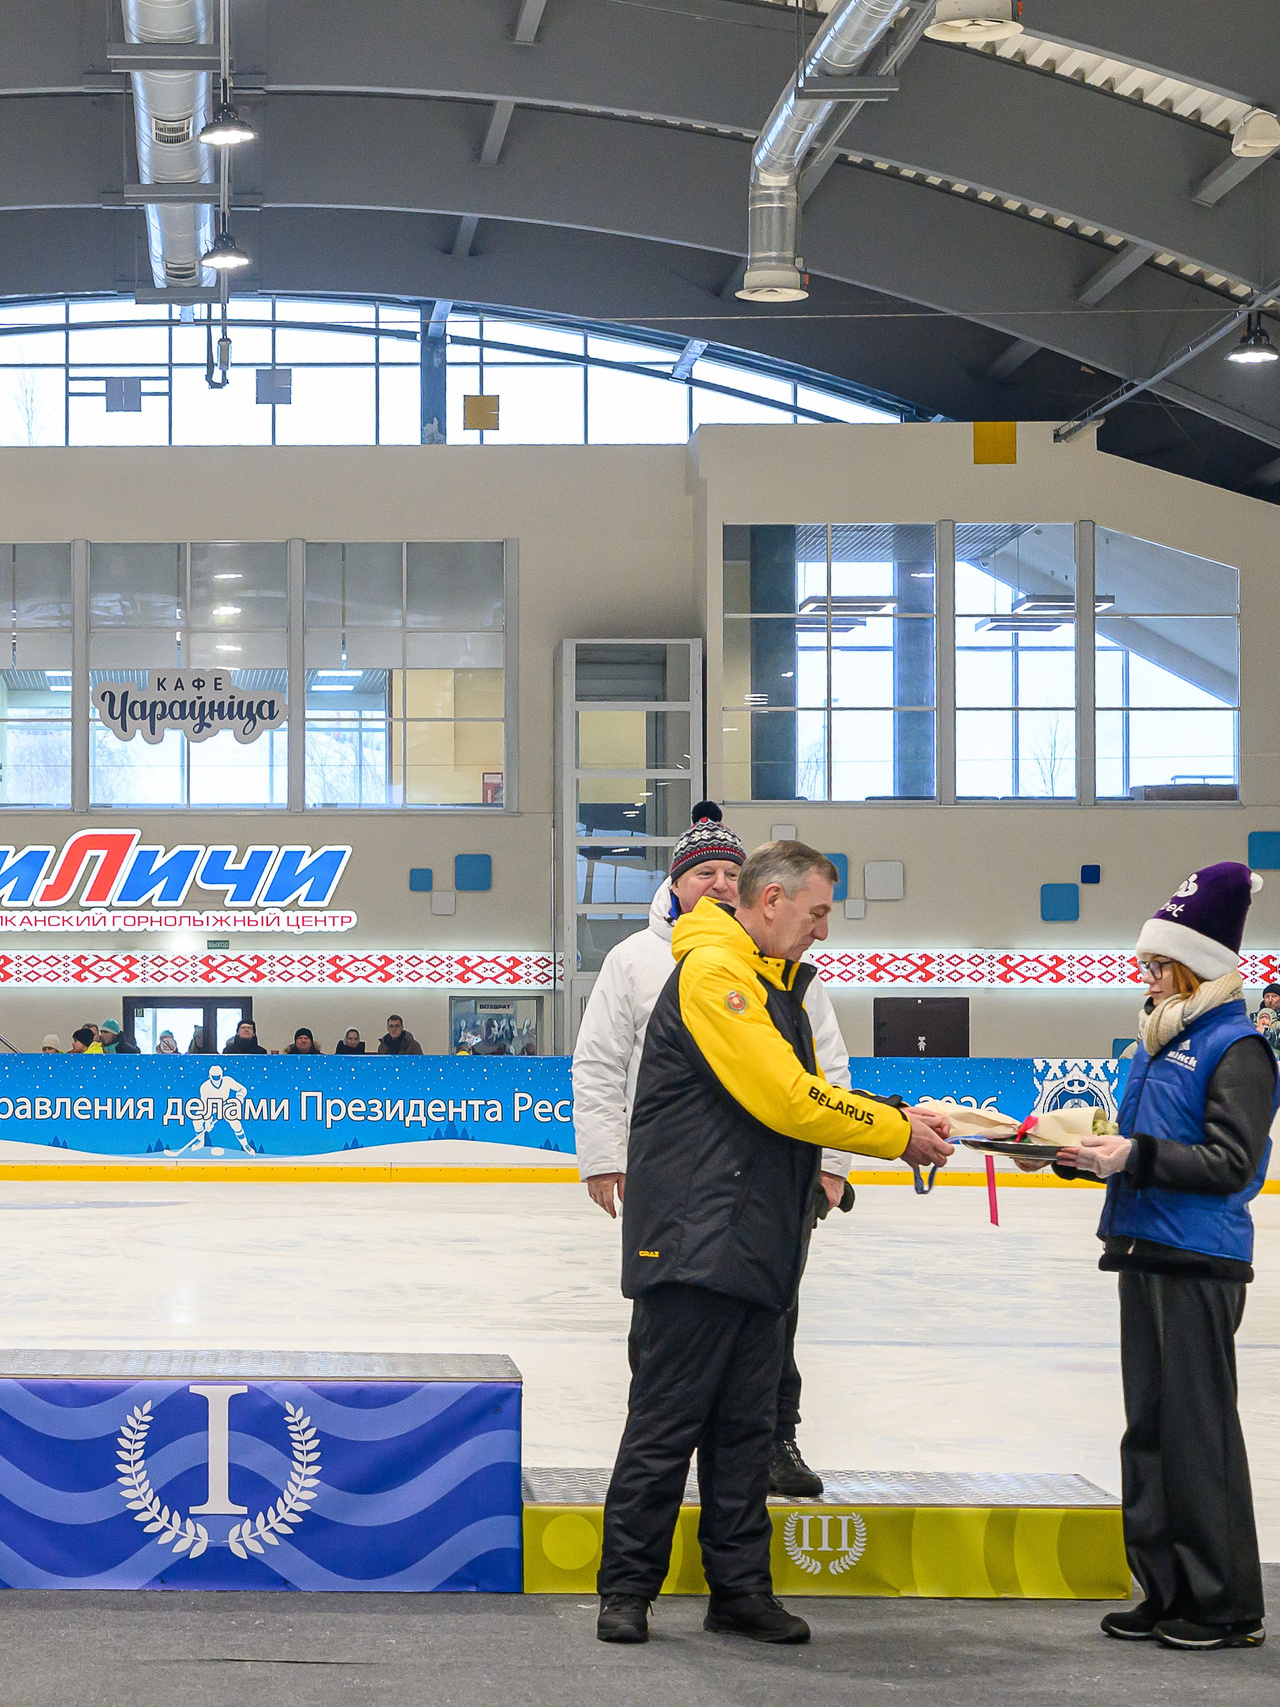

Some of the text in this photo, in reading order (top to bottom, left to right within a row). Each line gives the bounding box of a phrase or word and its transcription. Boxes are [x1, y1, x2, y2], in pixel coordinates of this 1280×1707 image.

[157, 677, 223, 691] КАФЕ
[100, 690, 280, 736] Чараўніца
[111, 912, 281, 927] ГОРНОЛЫЖНЫЙ
[286, 915, 353, 930] ЦЕНТР
[162, 1096, 290, 1127] делами
[299, 1091, 504, 1128] Президента
[512, 1091, 574, 1123] Рес
[808, 1085, 875, 1126] BELARUS
[798, 1515, 853, 1551] III
